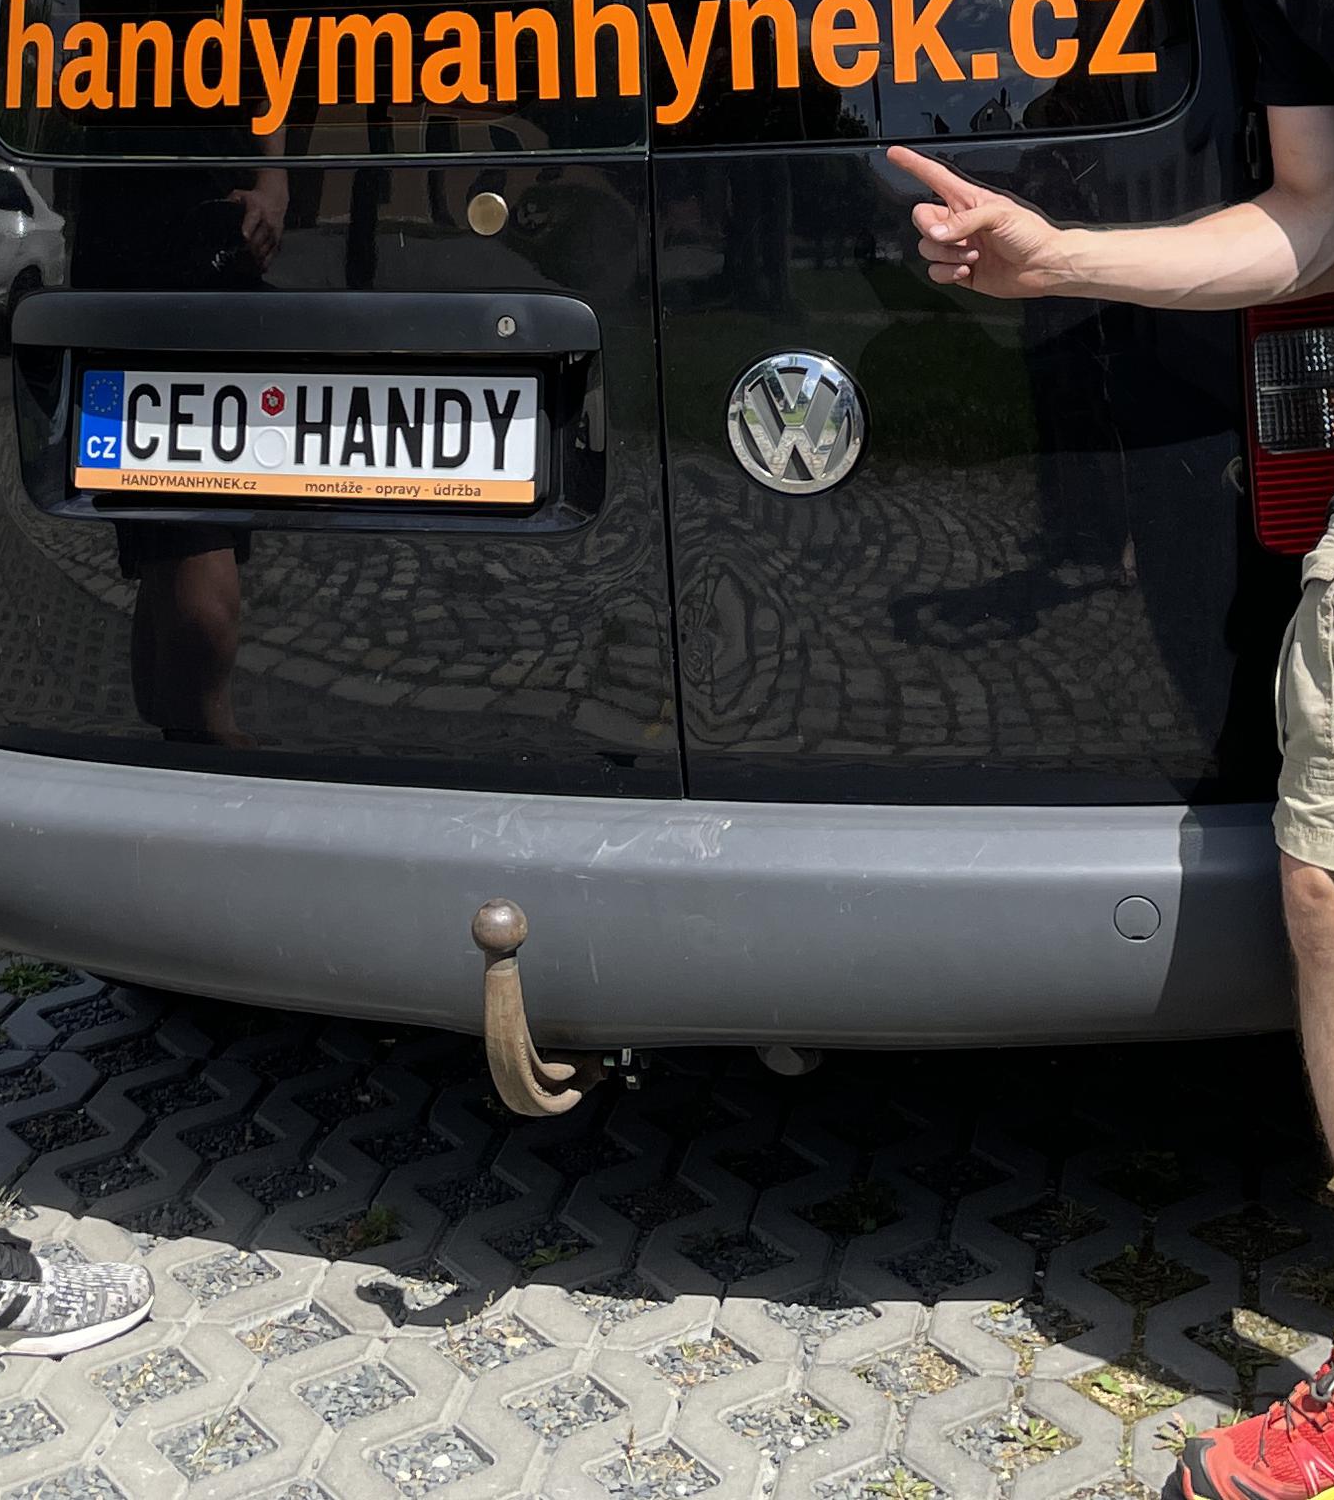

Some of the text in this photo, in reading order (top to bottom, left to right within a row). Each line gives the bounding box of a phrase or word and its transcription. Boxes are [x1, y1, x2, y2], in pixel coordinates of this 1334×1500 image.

[127, 383, 521, 470] CEO HANDY
[86, 435, 116, 459] CZ
[120, 473, 257, 491] HANDYMANHYNEK.cz
[304, 481, 364, 494] montáže
[375, 484, 421, 498] opravy
[433, 483, 482, 497] údržba
